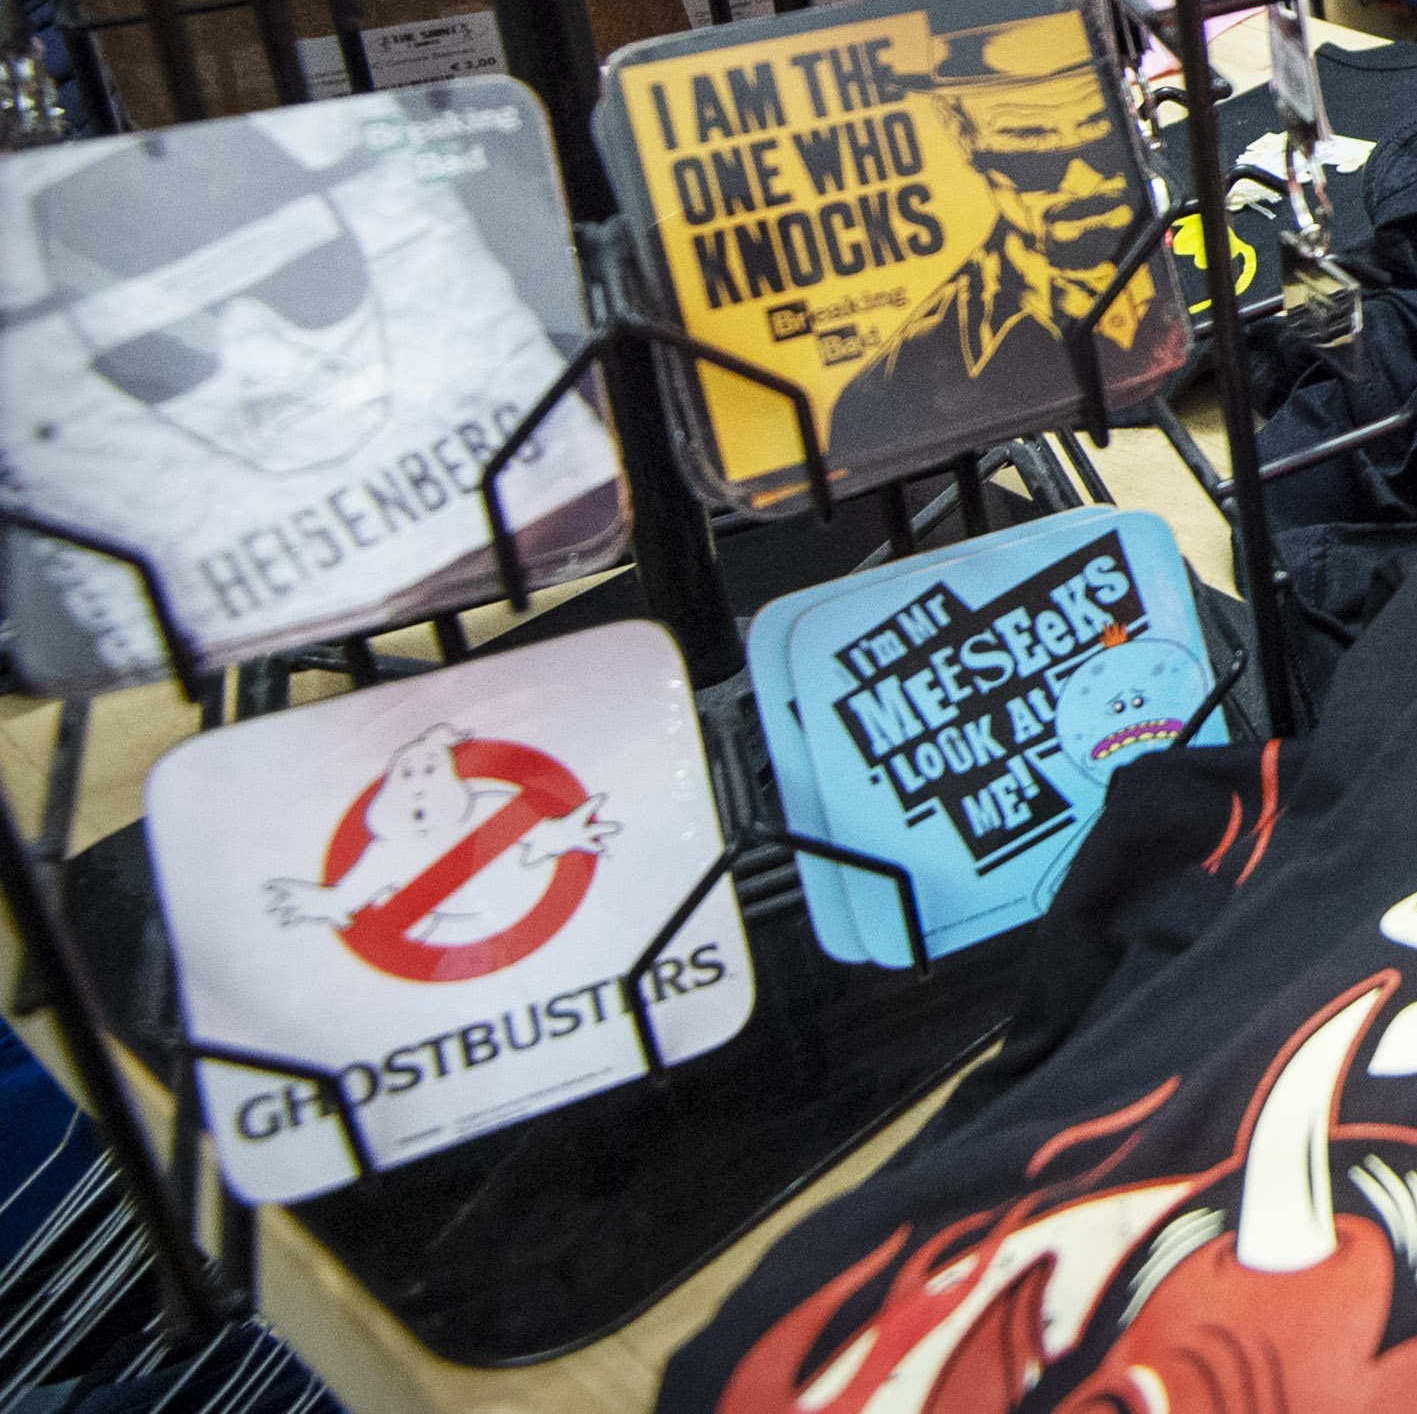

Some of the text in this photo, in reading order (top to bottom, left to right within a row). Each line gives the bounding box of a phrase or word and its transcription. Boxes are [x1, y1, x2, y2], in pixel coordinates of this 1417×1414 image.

[651, 36, 906, 152] I AM THE
[672, 109, 924, 227] ONE WHO
[693, 182, 945, 310] KNOCKS
[849, 592, 952, 680] I'm Mr
[960, 754, 1041, 838] ME!
